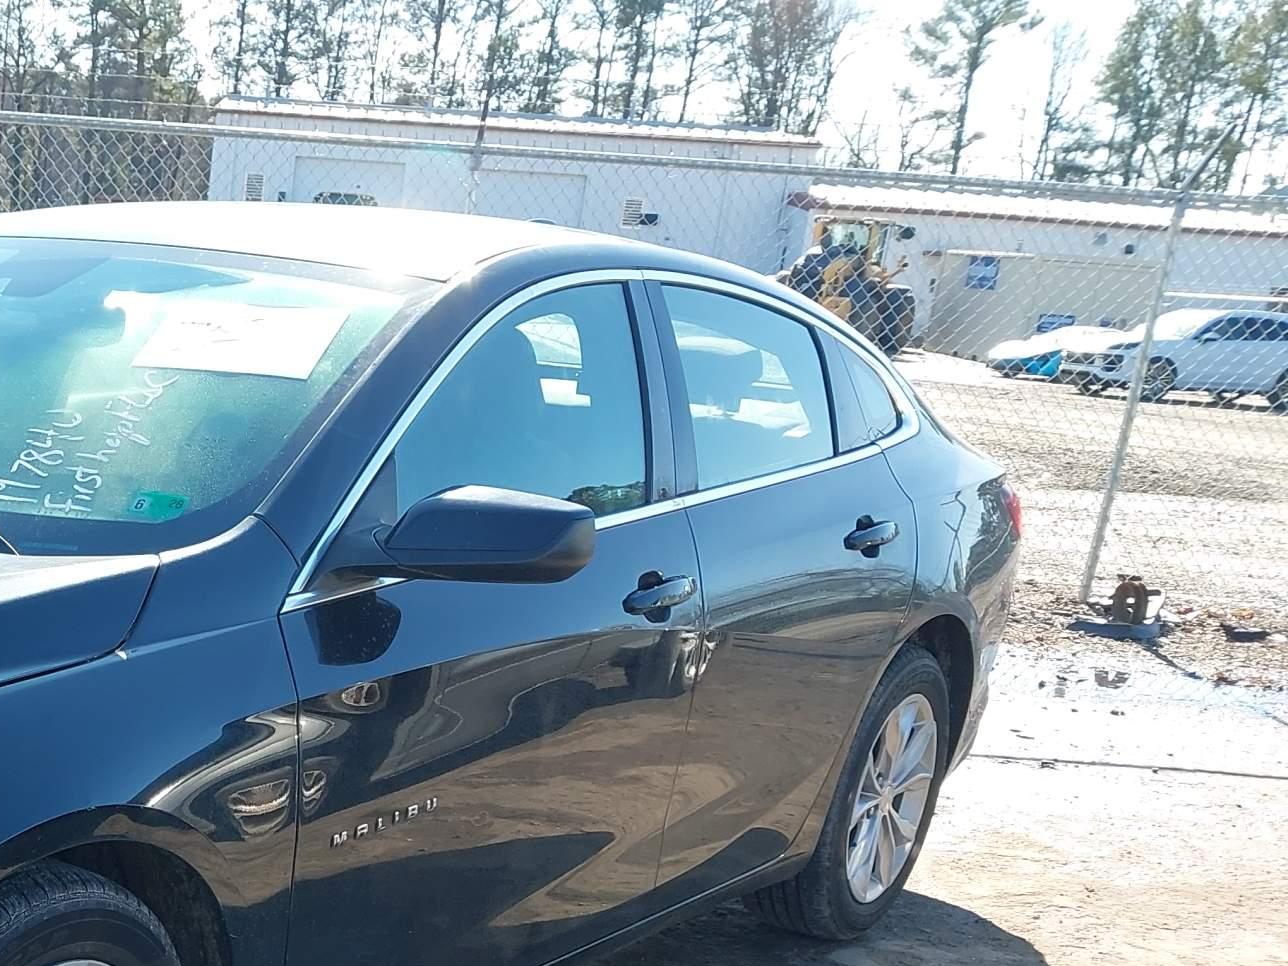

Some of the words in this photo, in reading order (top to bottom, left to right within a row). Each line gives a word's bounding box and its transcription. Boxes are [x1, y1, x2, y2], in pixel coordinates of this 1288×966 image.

[134, 498, 146, 510] 6
[167, 497, 185, 510] 28
[330, 797, 438, 848] MALIBU
